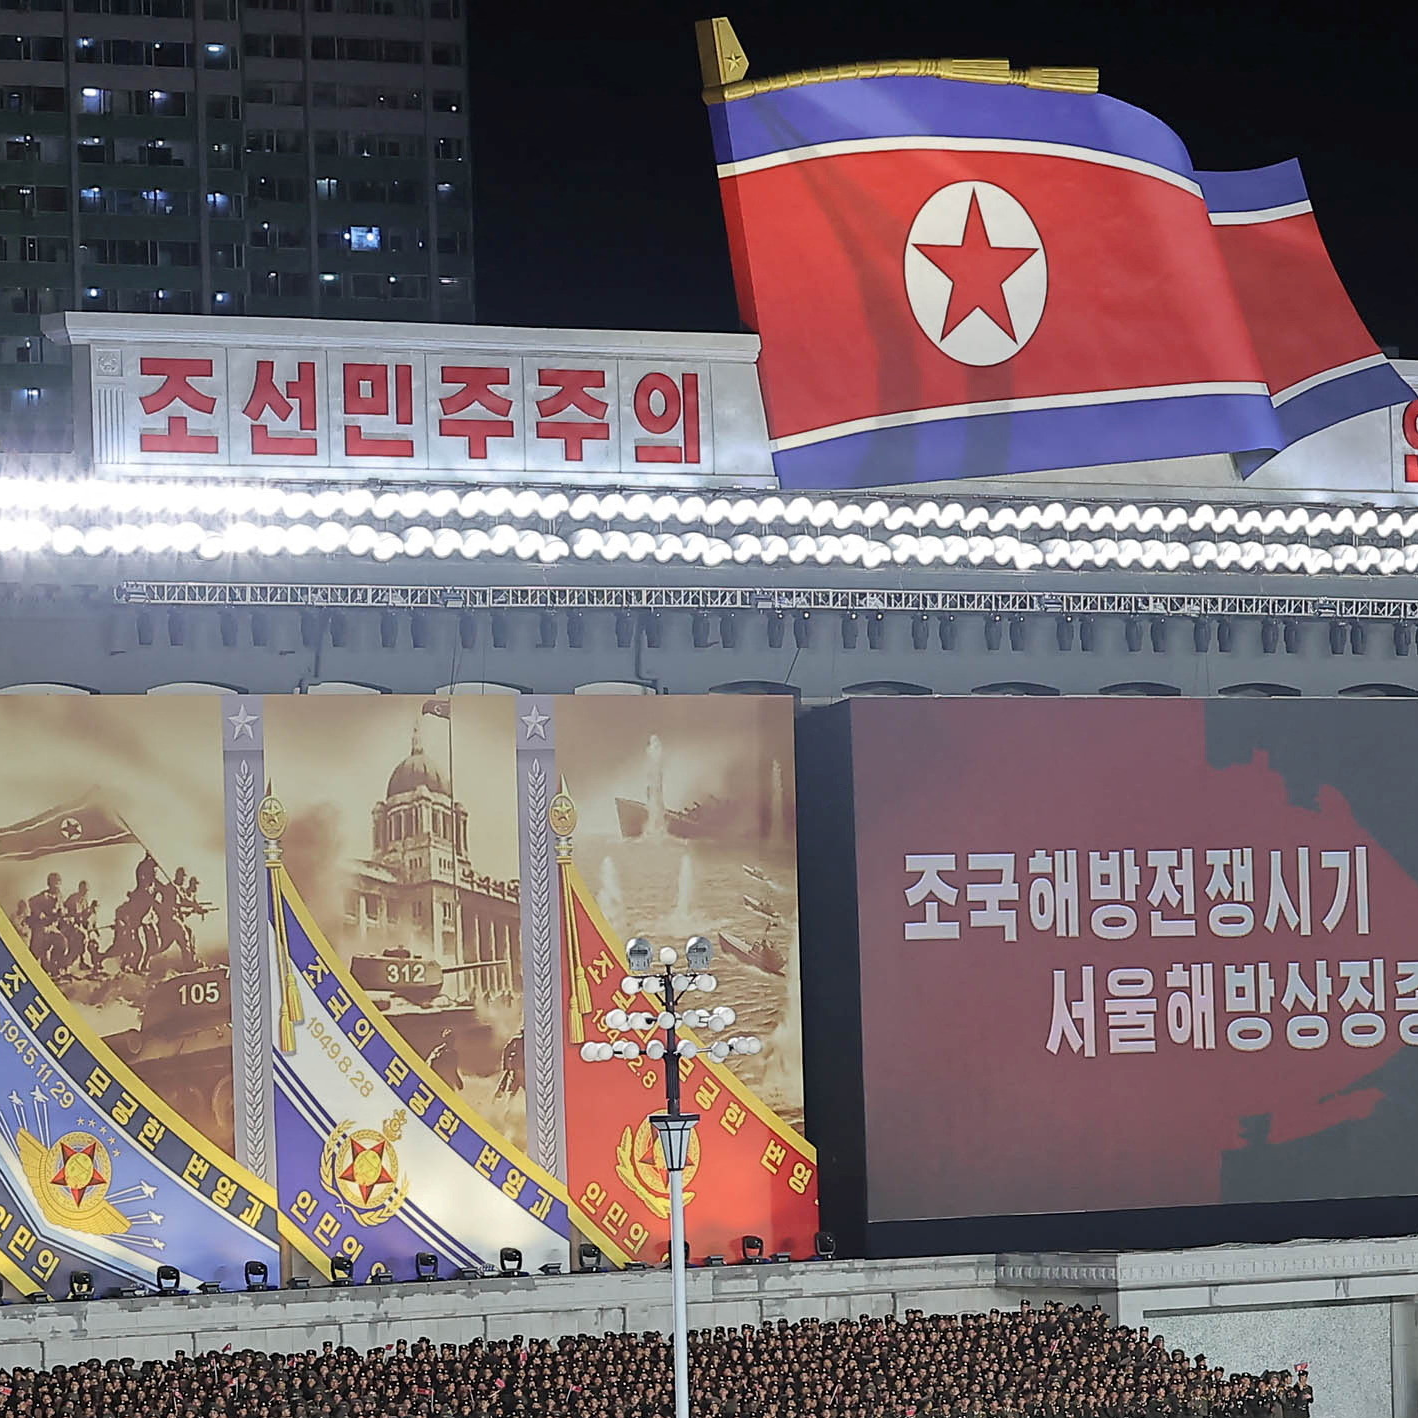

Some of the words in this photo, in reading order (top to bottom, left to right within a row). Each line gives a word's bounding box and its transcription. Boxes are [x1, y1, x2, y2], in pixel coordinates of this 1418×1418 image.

[139, 356, 700, 465] 조선민주주의
[903, 846, 1371, 942] 조국해방전쟁시기
[178, 981, 221, 1005] 105
[387, 963, 426, 984] 312
[302, 955, 376, 1050] 조국의
[384, 1056, 462, 1144] 무궁한
[474, 1144, 553, 1222] 번영과
[306, 1016, 375, 1099] 1949.8.28
[85, 1066, 165, 1151] 무궁한
[183, 1153, 266, 1229] 번영과
[290, 1190, 363, 1263] 인민의
[580, 1182, 650, 1255] 인민의
